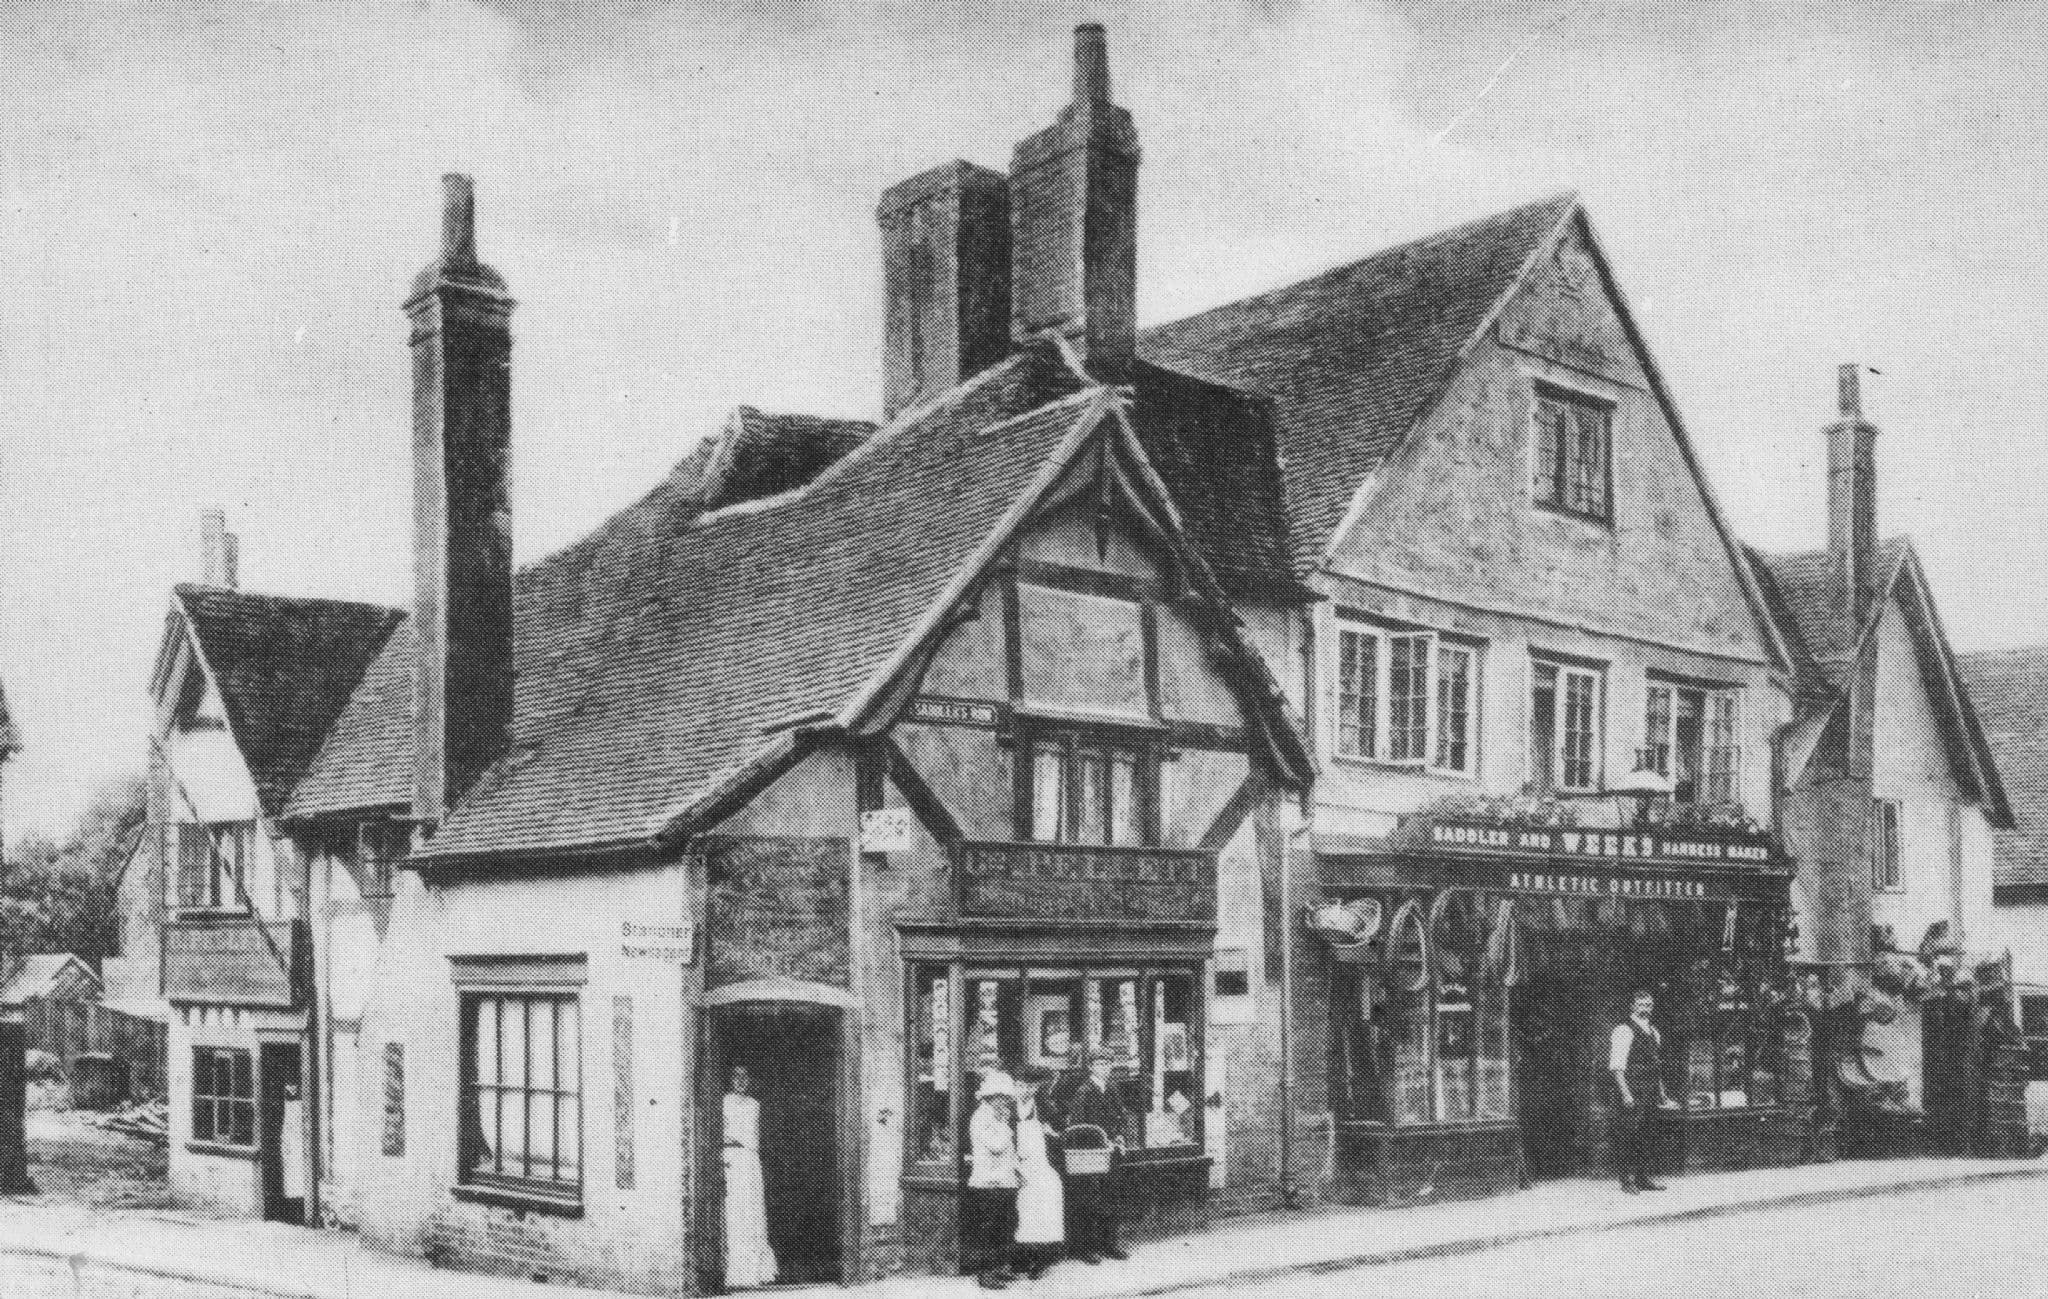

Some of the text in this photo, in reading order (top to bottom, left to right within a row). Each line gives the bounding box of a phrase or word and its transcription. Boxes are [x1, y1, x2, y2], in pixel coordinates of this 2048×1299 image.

[1433, 825, 1768, 861] SADDLER AND WEEKS HARNESS MAKER
[1510, 873, 1704, 897] ATHLETIC OUTFITTER
